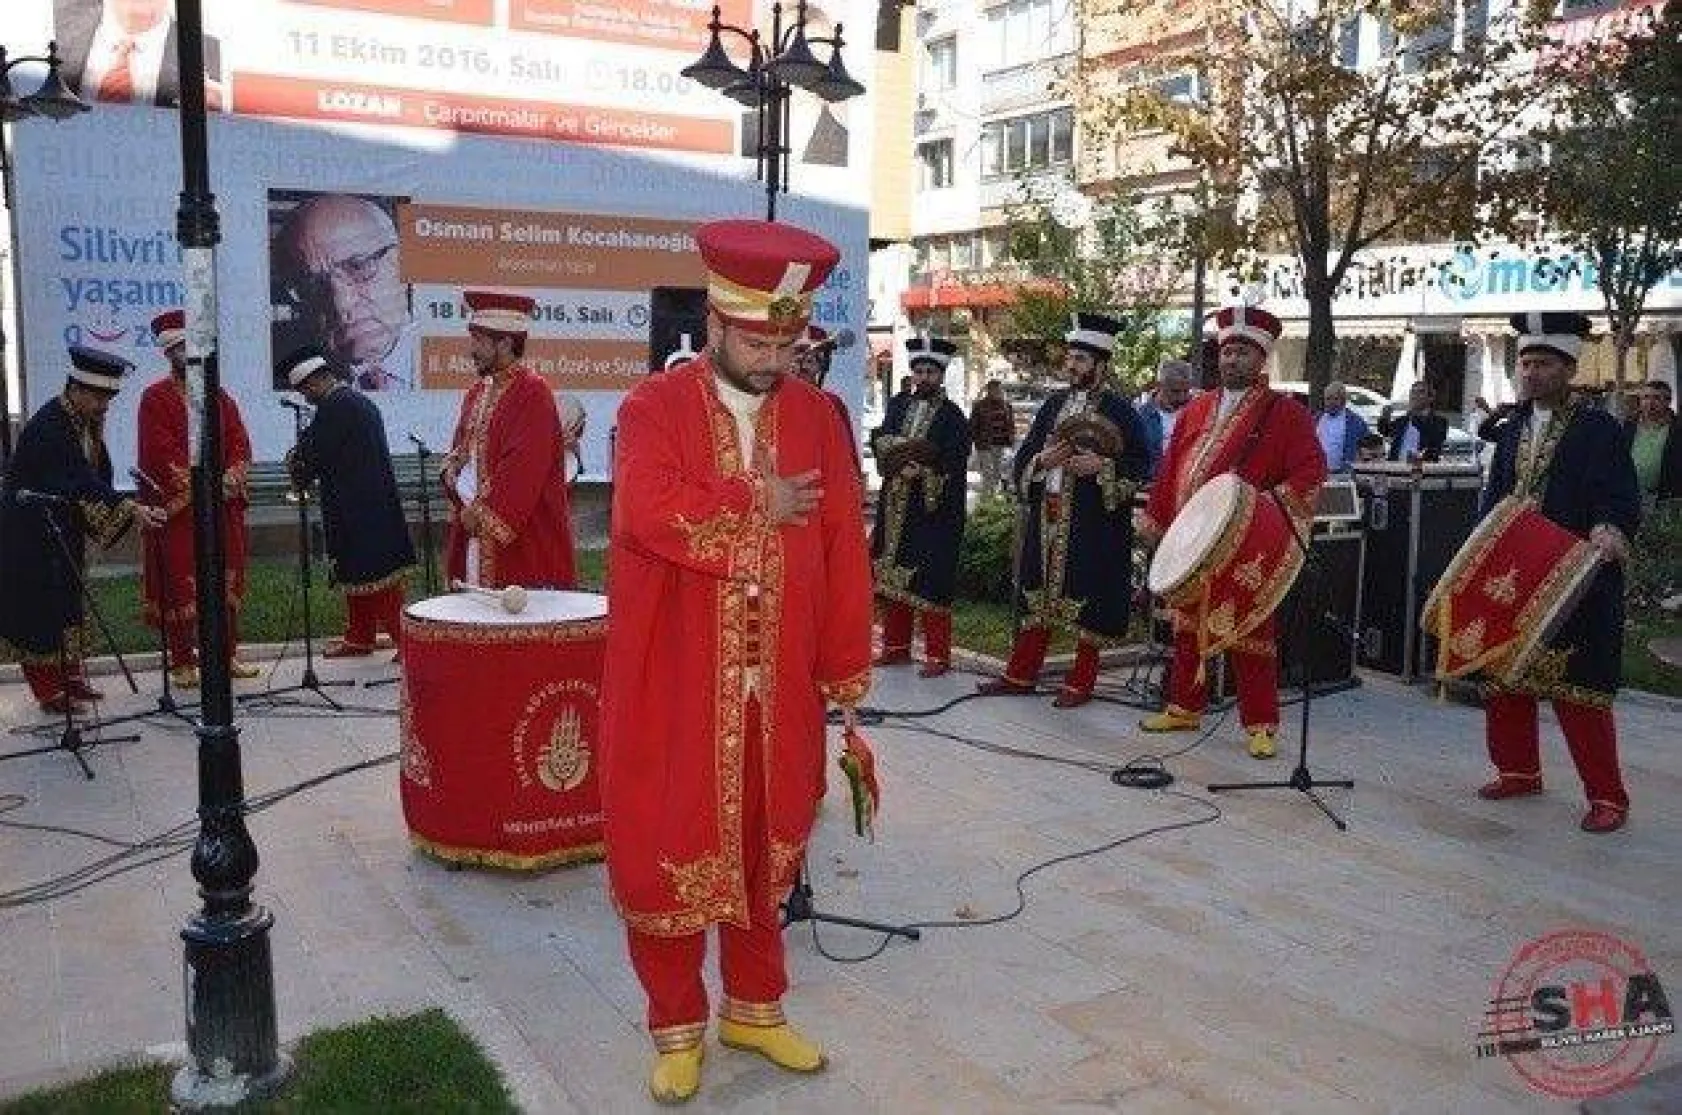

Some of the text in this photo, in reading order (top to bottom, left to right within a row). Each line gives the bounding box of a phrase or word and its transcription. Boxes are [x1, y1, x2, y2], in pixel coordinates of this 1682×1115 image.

[288, 31, 319, 56] 11
[331, 34, 406, 66] Ekim
[418, 44, 499, 76] 2016,
[414, 218, 494, 241] Osman
[500, 221, 561, 245] Selim
[428, 301, 454, 320] 18
[531, 303, 572, 324] 016,
[577, 305, 614, 324] Salı
